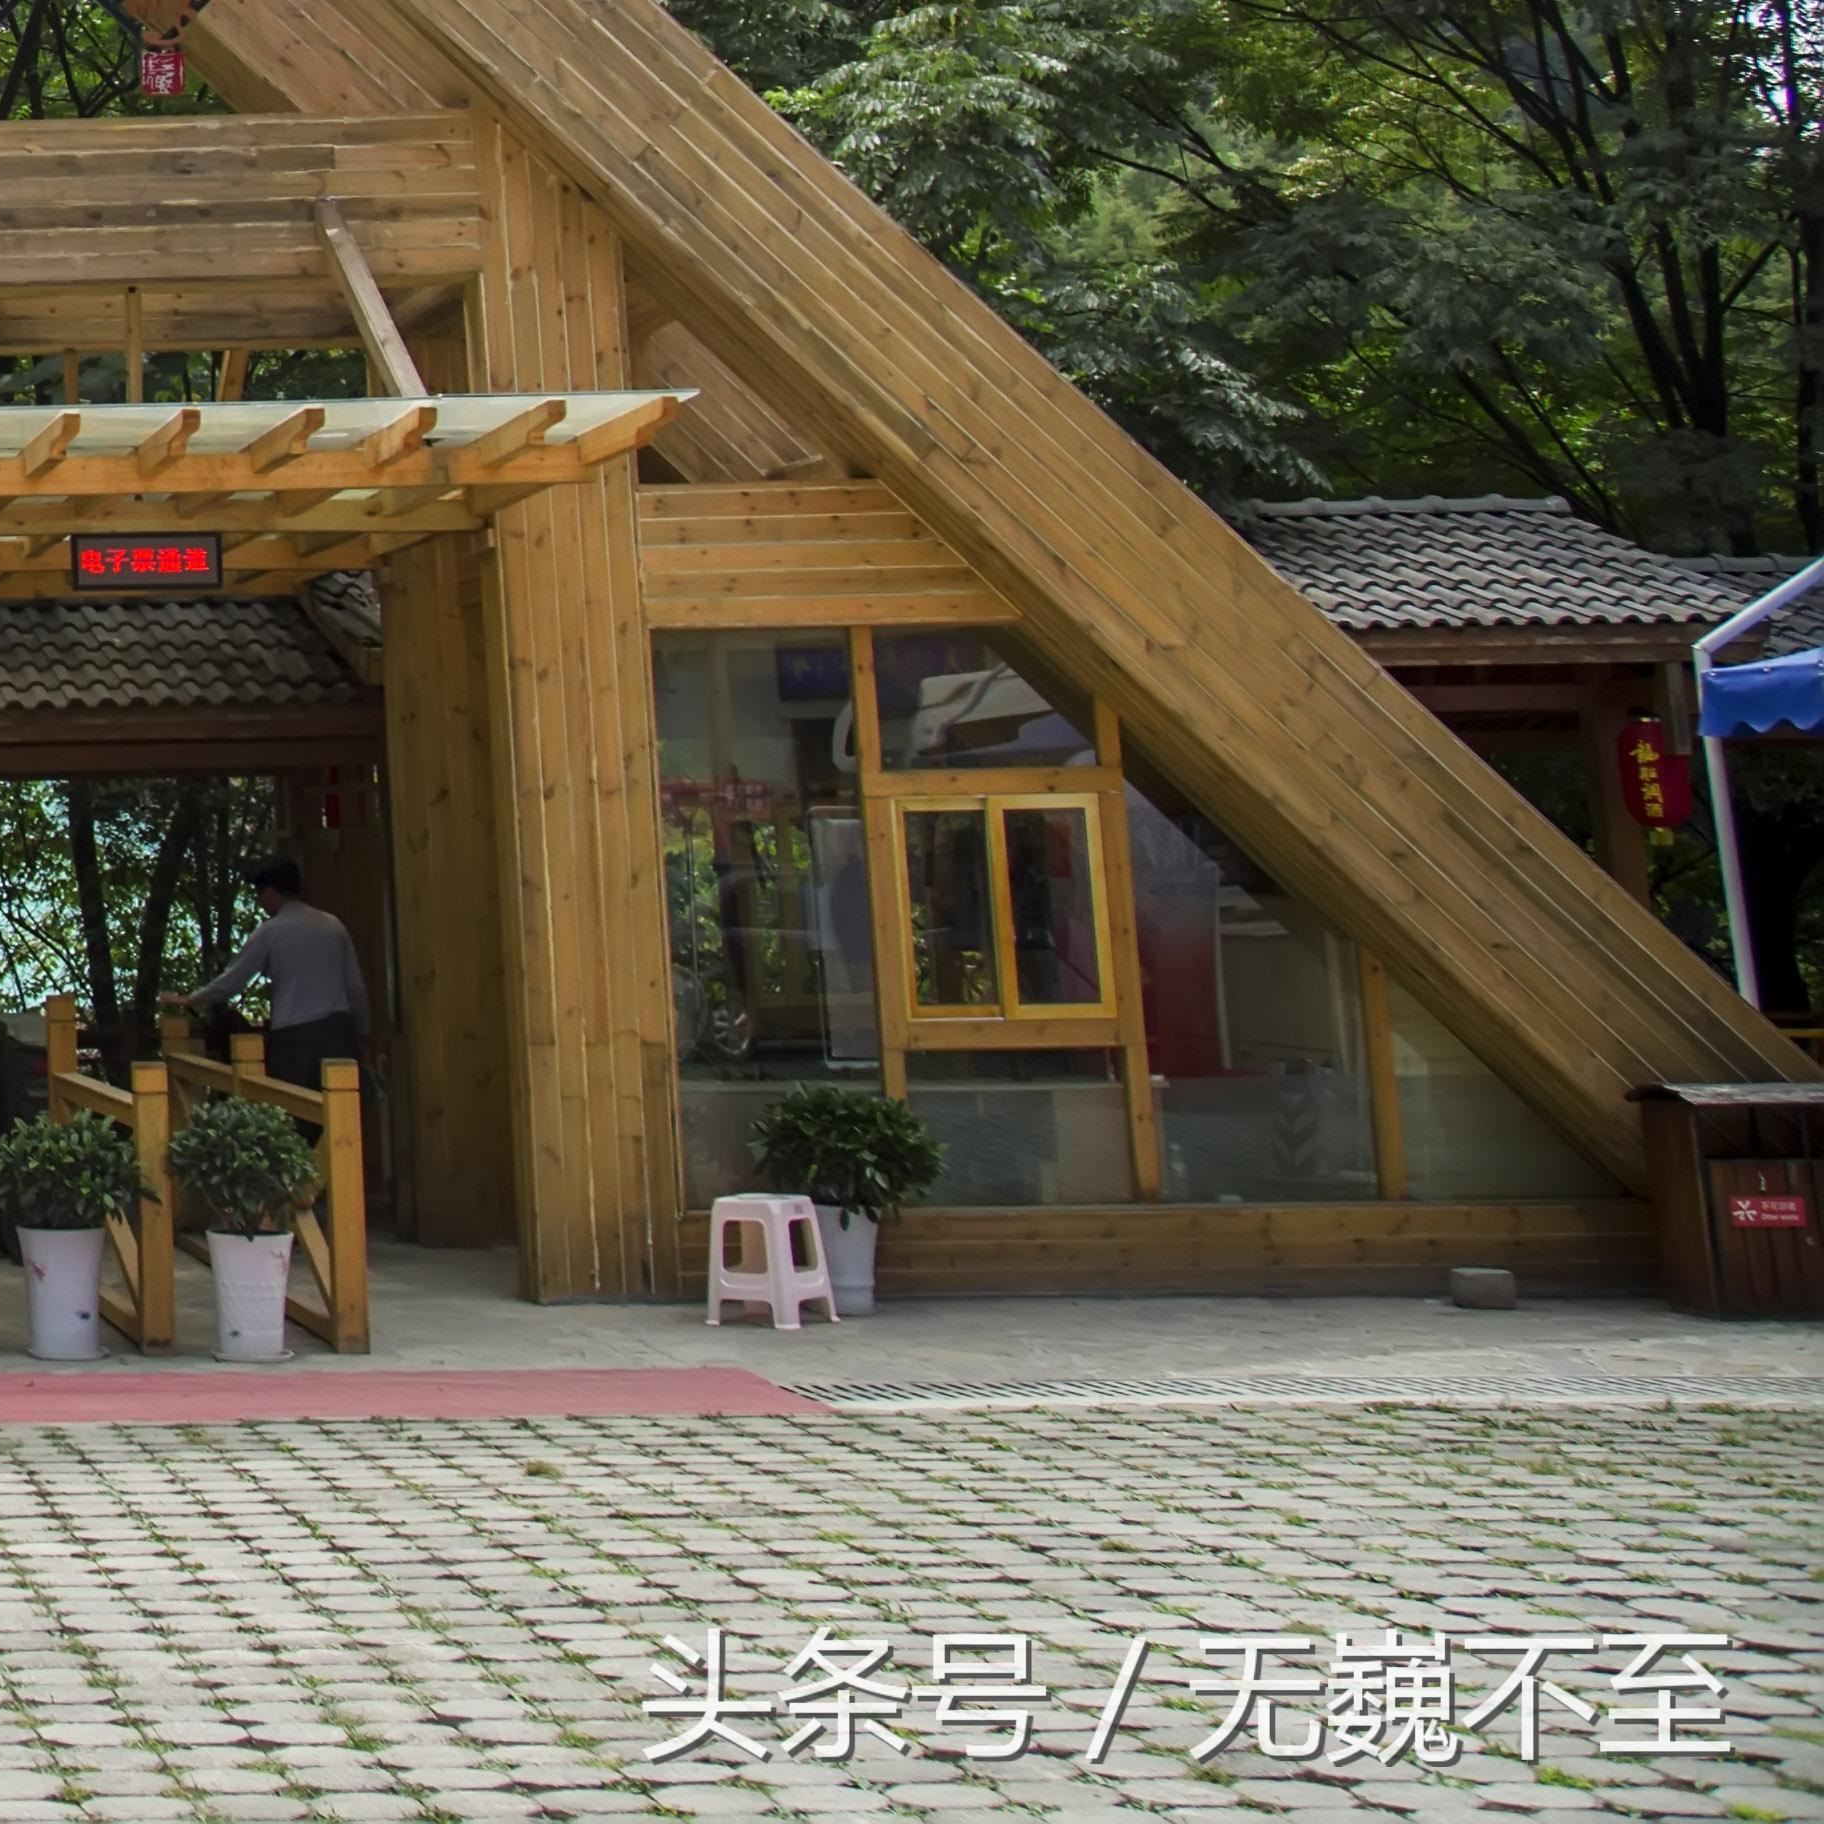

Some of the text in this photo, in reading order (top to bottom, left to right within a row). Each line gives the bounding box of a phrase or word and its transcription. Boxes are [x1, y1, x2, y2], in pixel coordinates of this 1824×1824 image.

[80, 546, 210, 575] 电子票通道
